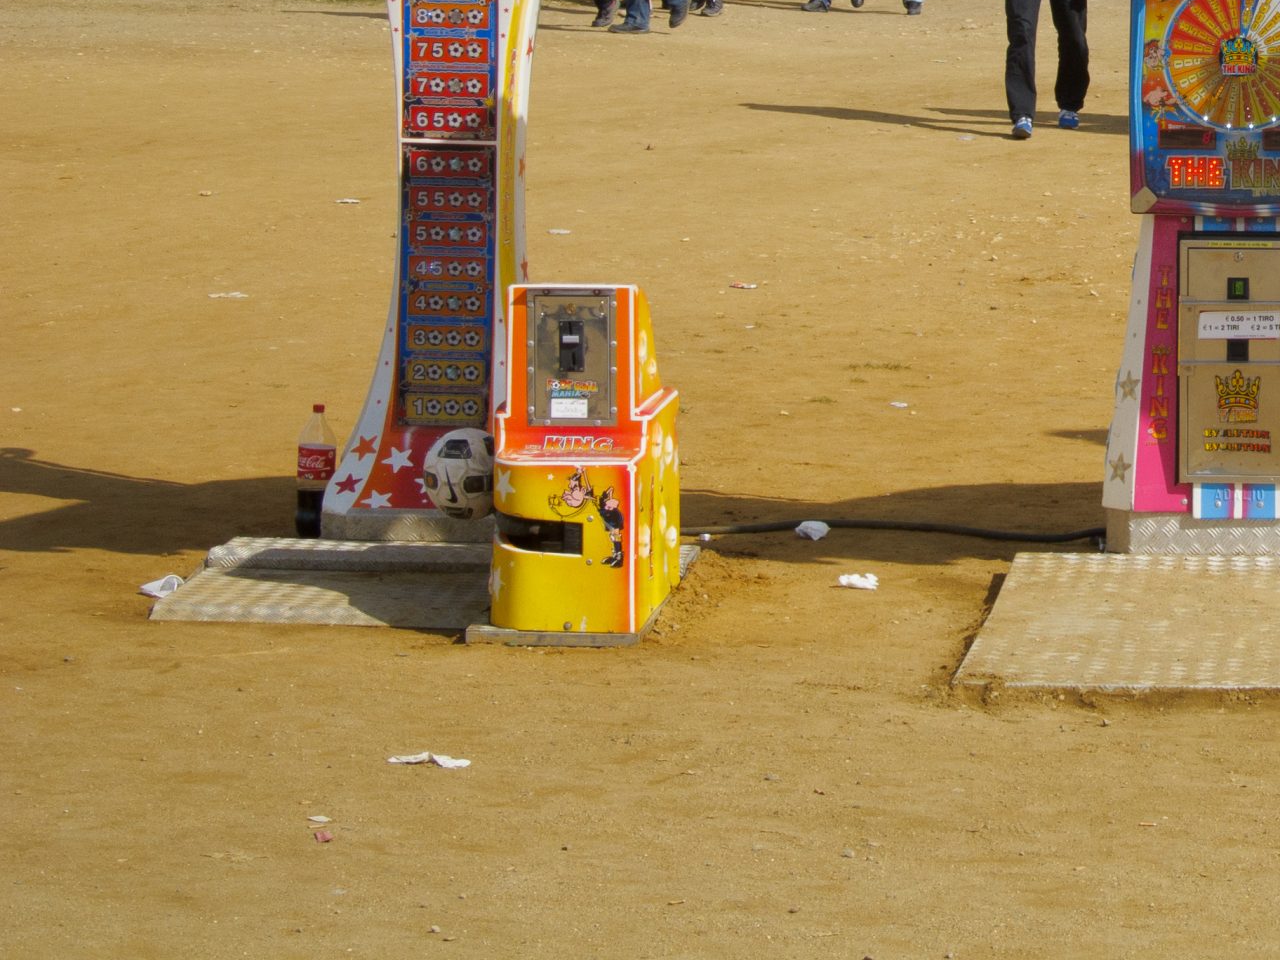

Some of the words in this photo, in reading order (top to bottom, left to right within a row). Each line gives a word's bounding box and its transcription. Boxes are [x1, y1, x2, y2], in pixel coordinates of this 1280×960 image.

[1165, 155, 1227, 189] THE
[1155, 264, 1173, 330] THE
[1148, 352, 1170, 440] KING
[542, 435, 614, 451] KING
